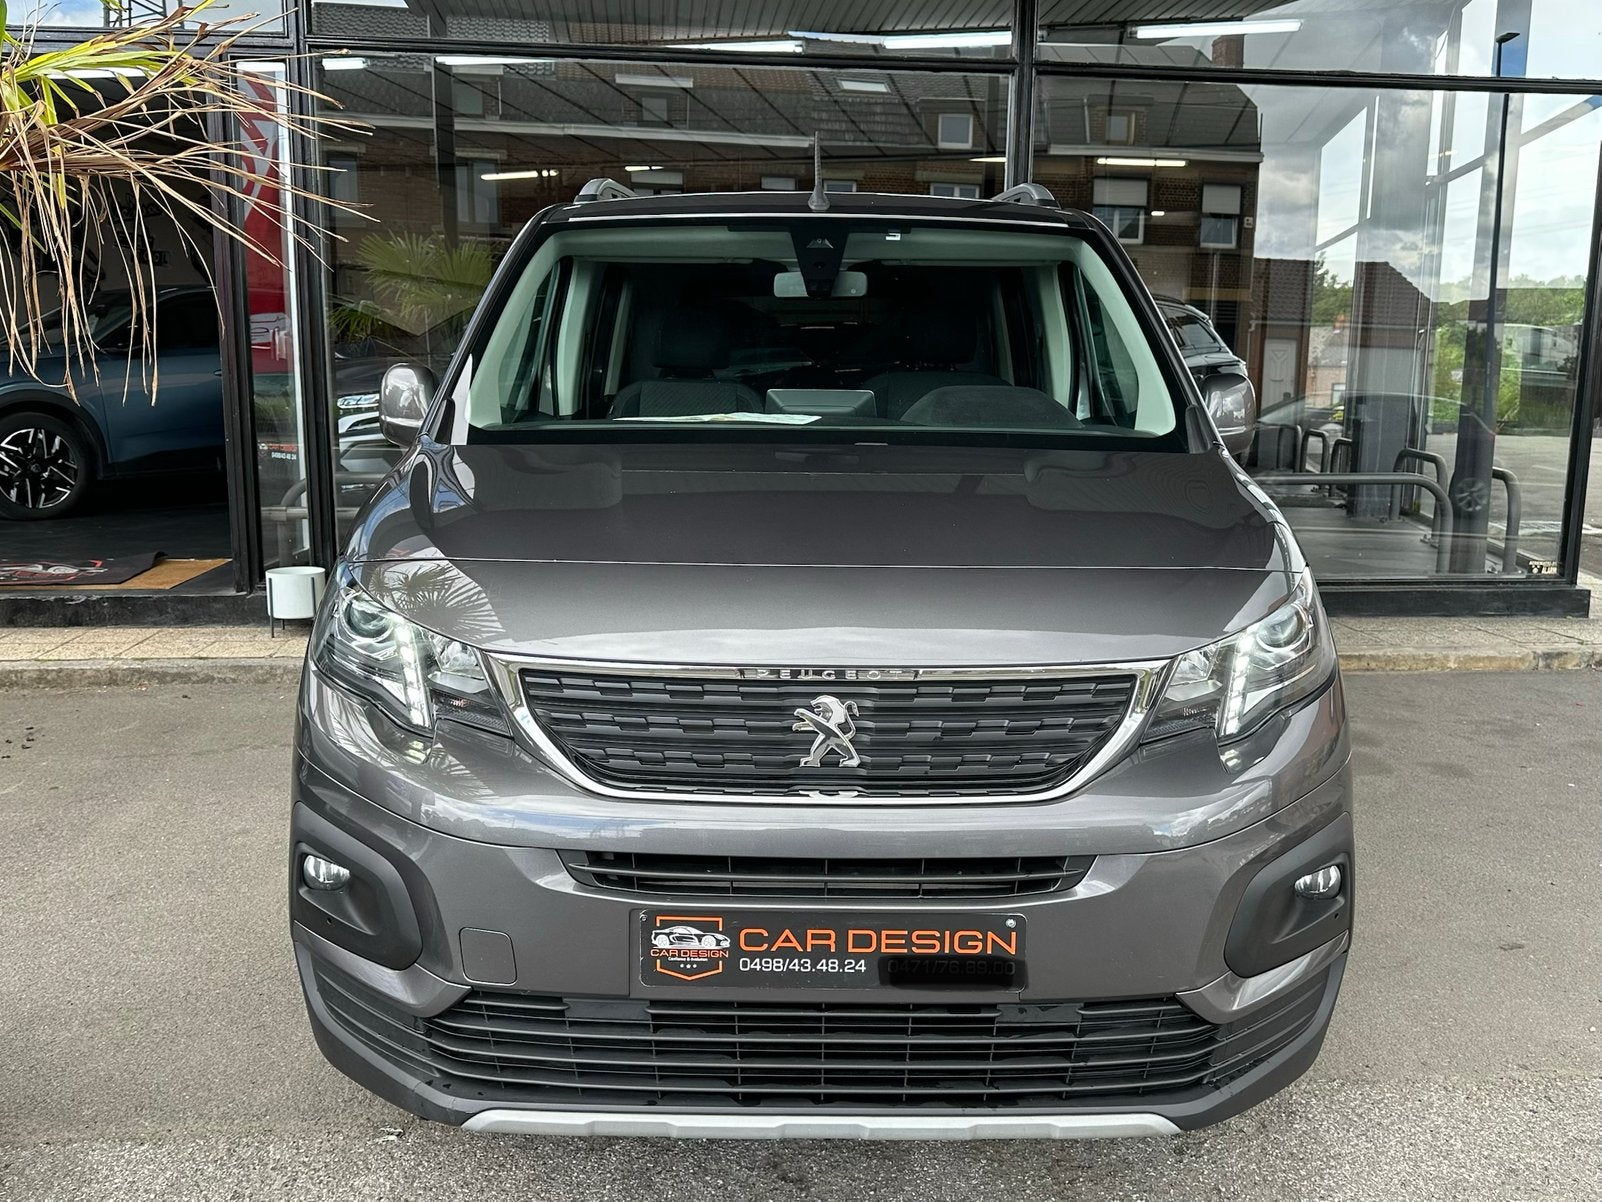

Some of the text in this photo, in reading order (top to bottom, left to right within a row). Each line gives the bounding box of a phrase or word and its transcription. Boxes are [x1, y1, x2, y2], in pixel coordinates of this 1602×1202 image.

[756, 669, 903, 680] PEUGEOT
[739, 928, 1017, 955] CAR DESIGN
[650, 948, 729, 958] CAR DESIGN
[739, 957, 867, 973] 0498/43.48.24
